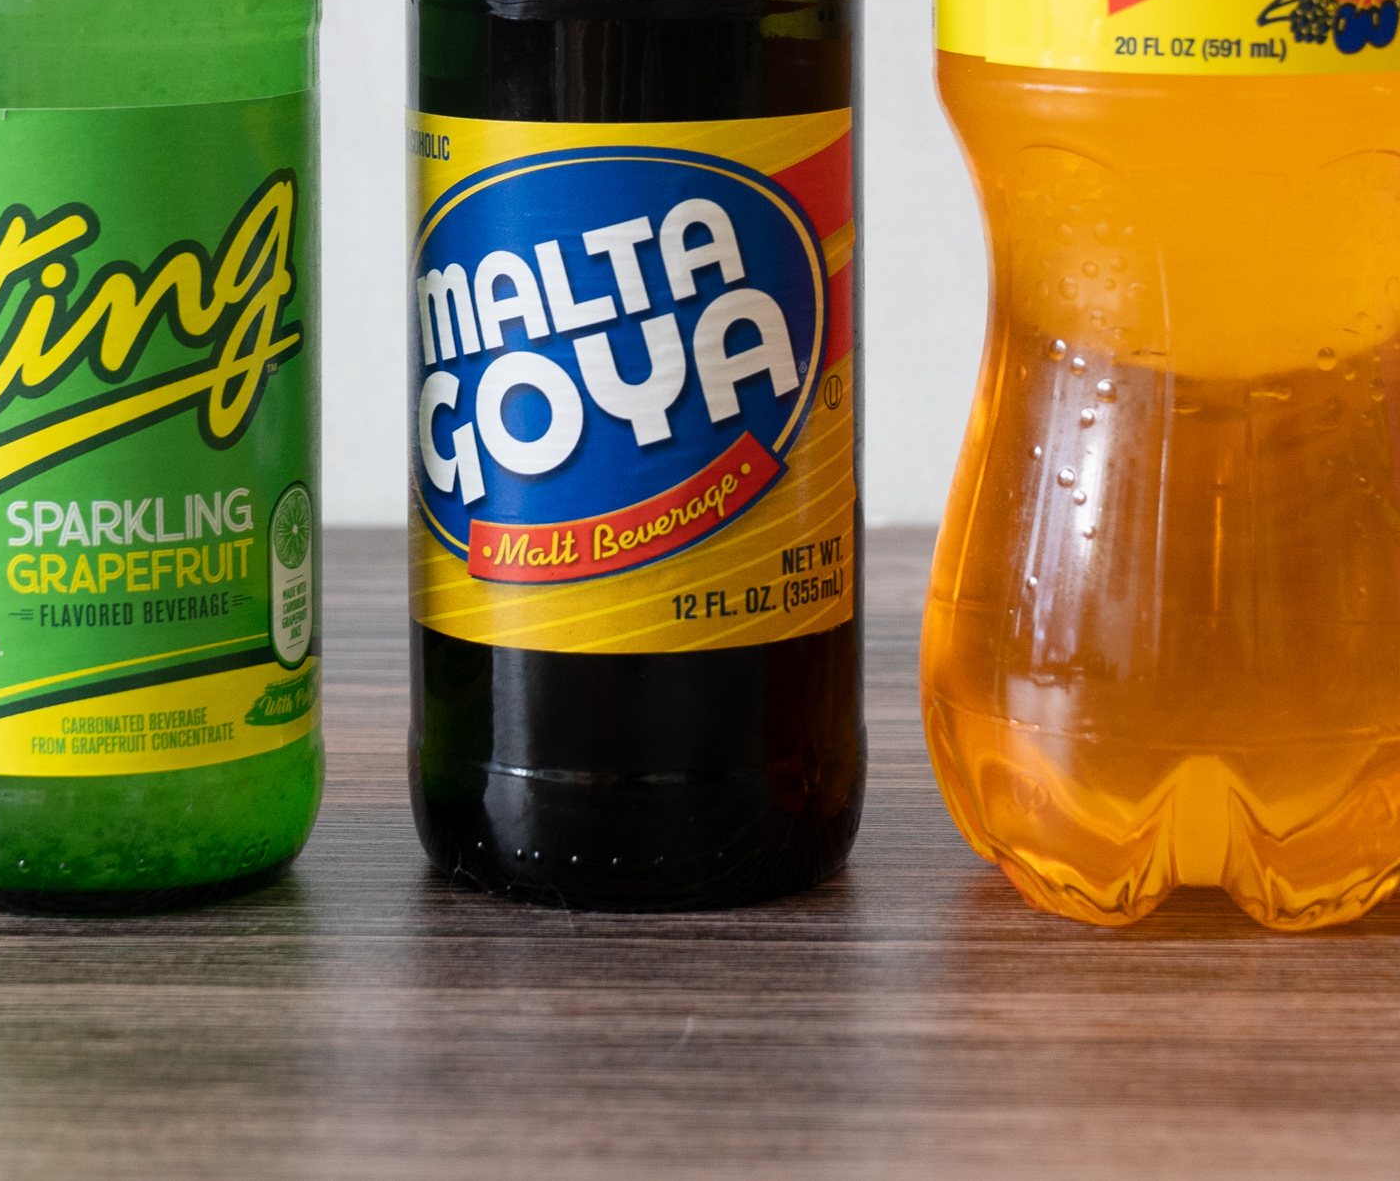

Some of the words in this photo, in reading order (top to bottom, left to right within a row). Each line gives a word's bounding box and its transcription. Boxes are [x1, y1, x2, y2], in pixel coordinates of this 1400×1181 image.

[1114, 35, 1138, 56] 20
[1143, 36, 1165, 56] FL
[1170, 36, 1196, 57] OZ
[1201, 37, 1243, 62] (591
[1249, 37, 1288, 63] mL)
[416, 197, 746, 366] MALTA
[418, 287, 800, 507] GOYA
[6, 487, 255, 547] SPARKLING
[493, 530, 579, 566] Malt
[593, 473, 739, 561] Beverage
[6, 537, 255, 595] GRAPEFRUIT
[781, 543, 816, 576] NET
[819, 535, 844, 567] WT.
[39, 601, 134, 628] FLAVORED
[143, 591, 230, 625] BEVERAGE
[672, 593, 698, 620] 12
[705, 590, 738, 618] FL.
[745, 585, 777, 614] OZ.
[30, 736, 67, 755] FROM
[71, 733, 148, 755] GRAPEFRUIT
[151, 721, 236, 751] CONCENTRATE
[61, 713, 145, 735] CARBONATED
[148, 706, 208, 731] BEVERAGE
